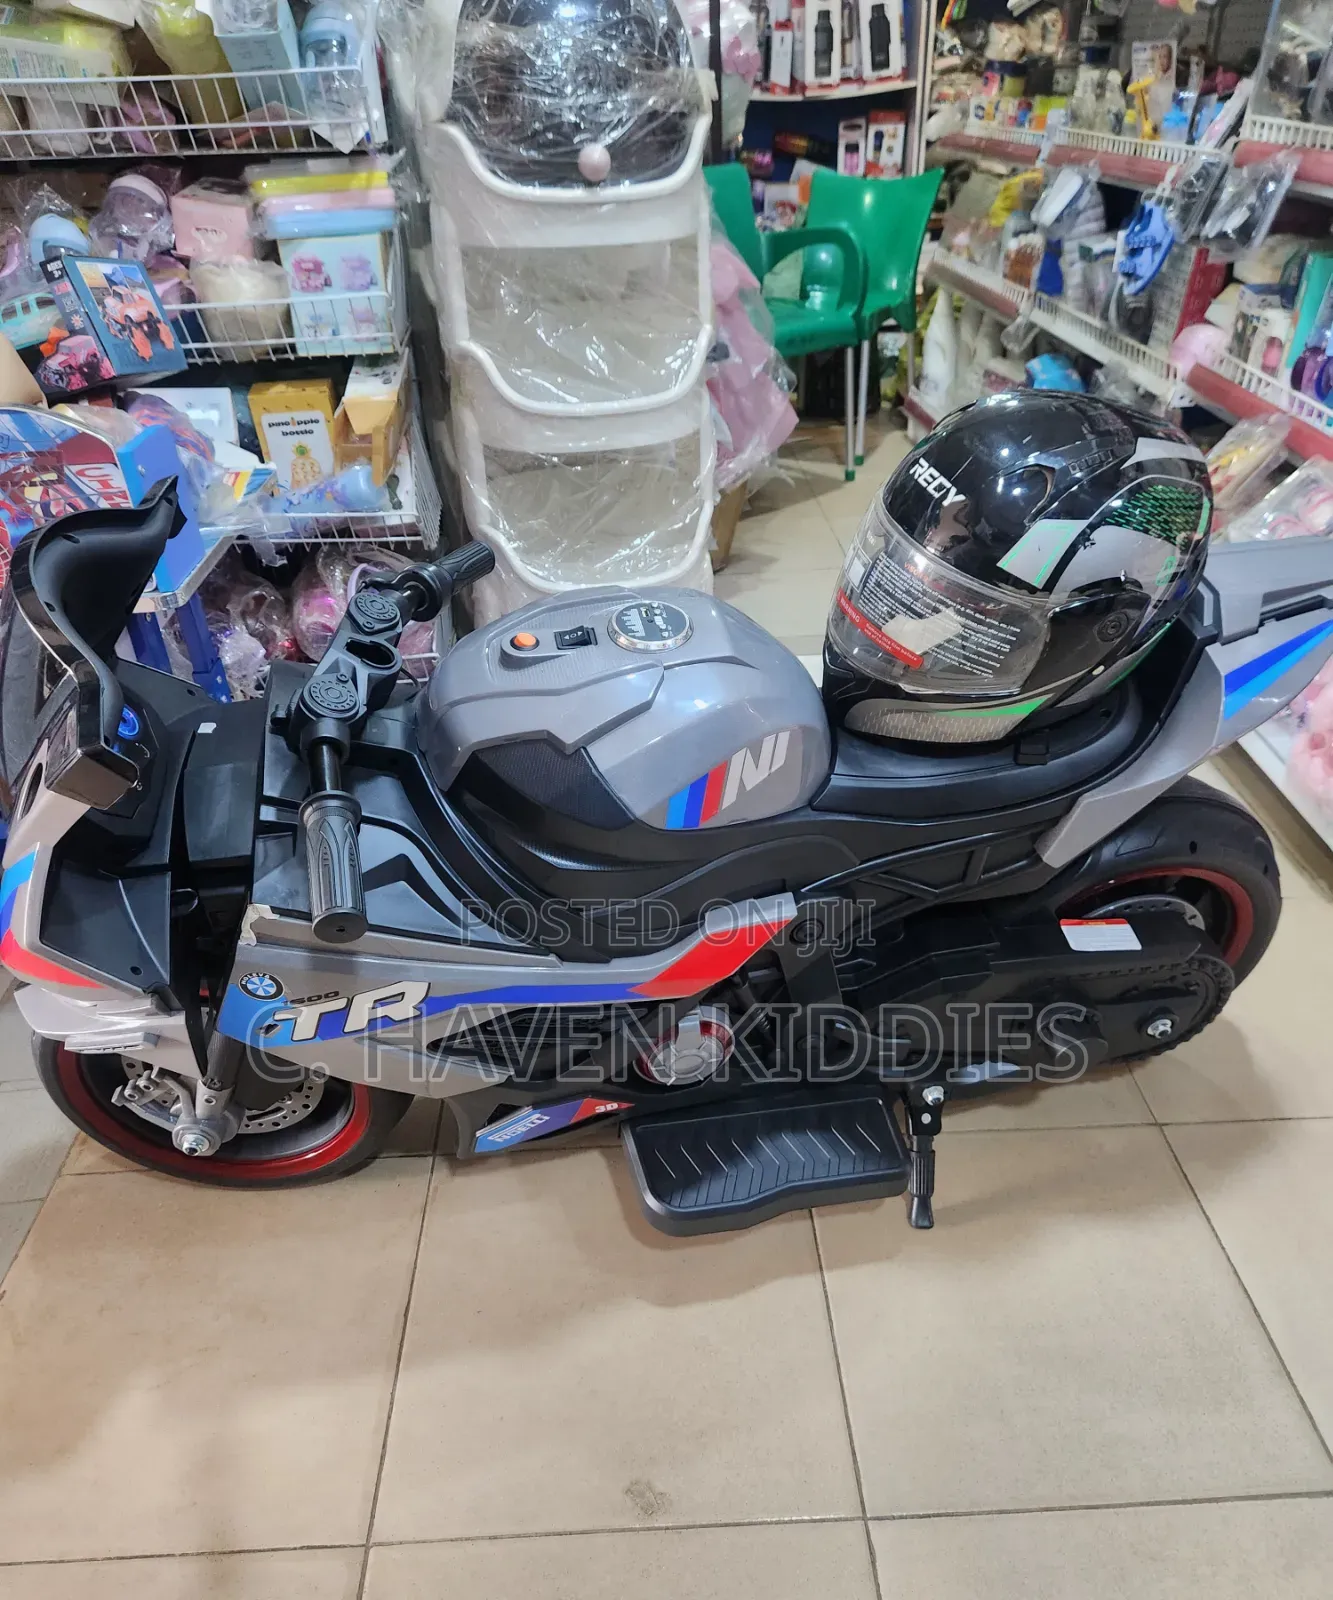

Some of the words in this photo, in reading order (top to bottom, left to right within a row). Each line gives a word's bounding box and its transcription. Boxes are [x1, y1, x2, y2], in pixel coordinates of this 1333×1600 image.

[281, 429, 314, 437] bottle
[840, 595, 861, 623] WARNING
[595, 1102, 619, 1113] 3D
